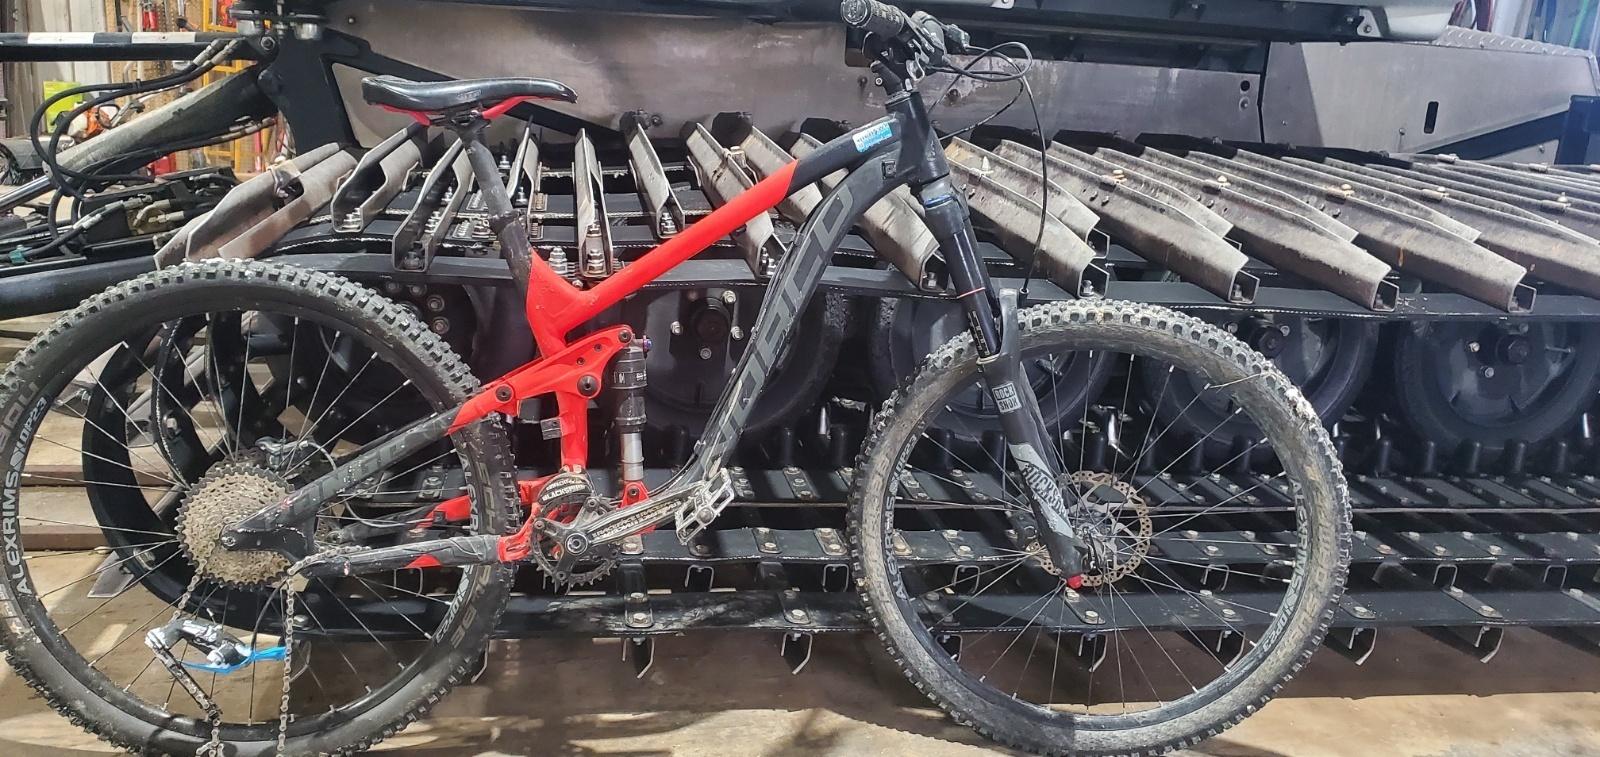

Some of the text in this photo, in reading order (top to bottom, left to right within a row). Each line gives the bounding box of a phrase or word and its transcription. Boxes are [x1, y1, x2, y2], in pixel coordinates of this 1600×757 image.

[700, 184, 854, 462] NORCO
[3, 471, 32, 595] ALEXRIMS
[1288, 478, 1308, 591] ALEXRIMS
